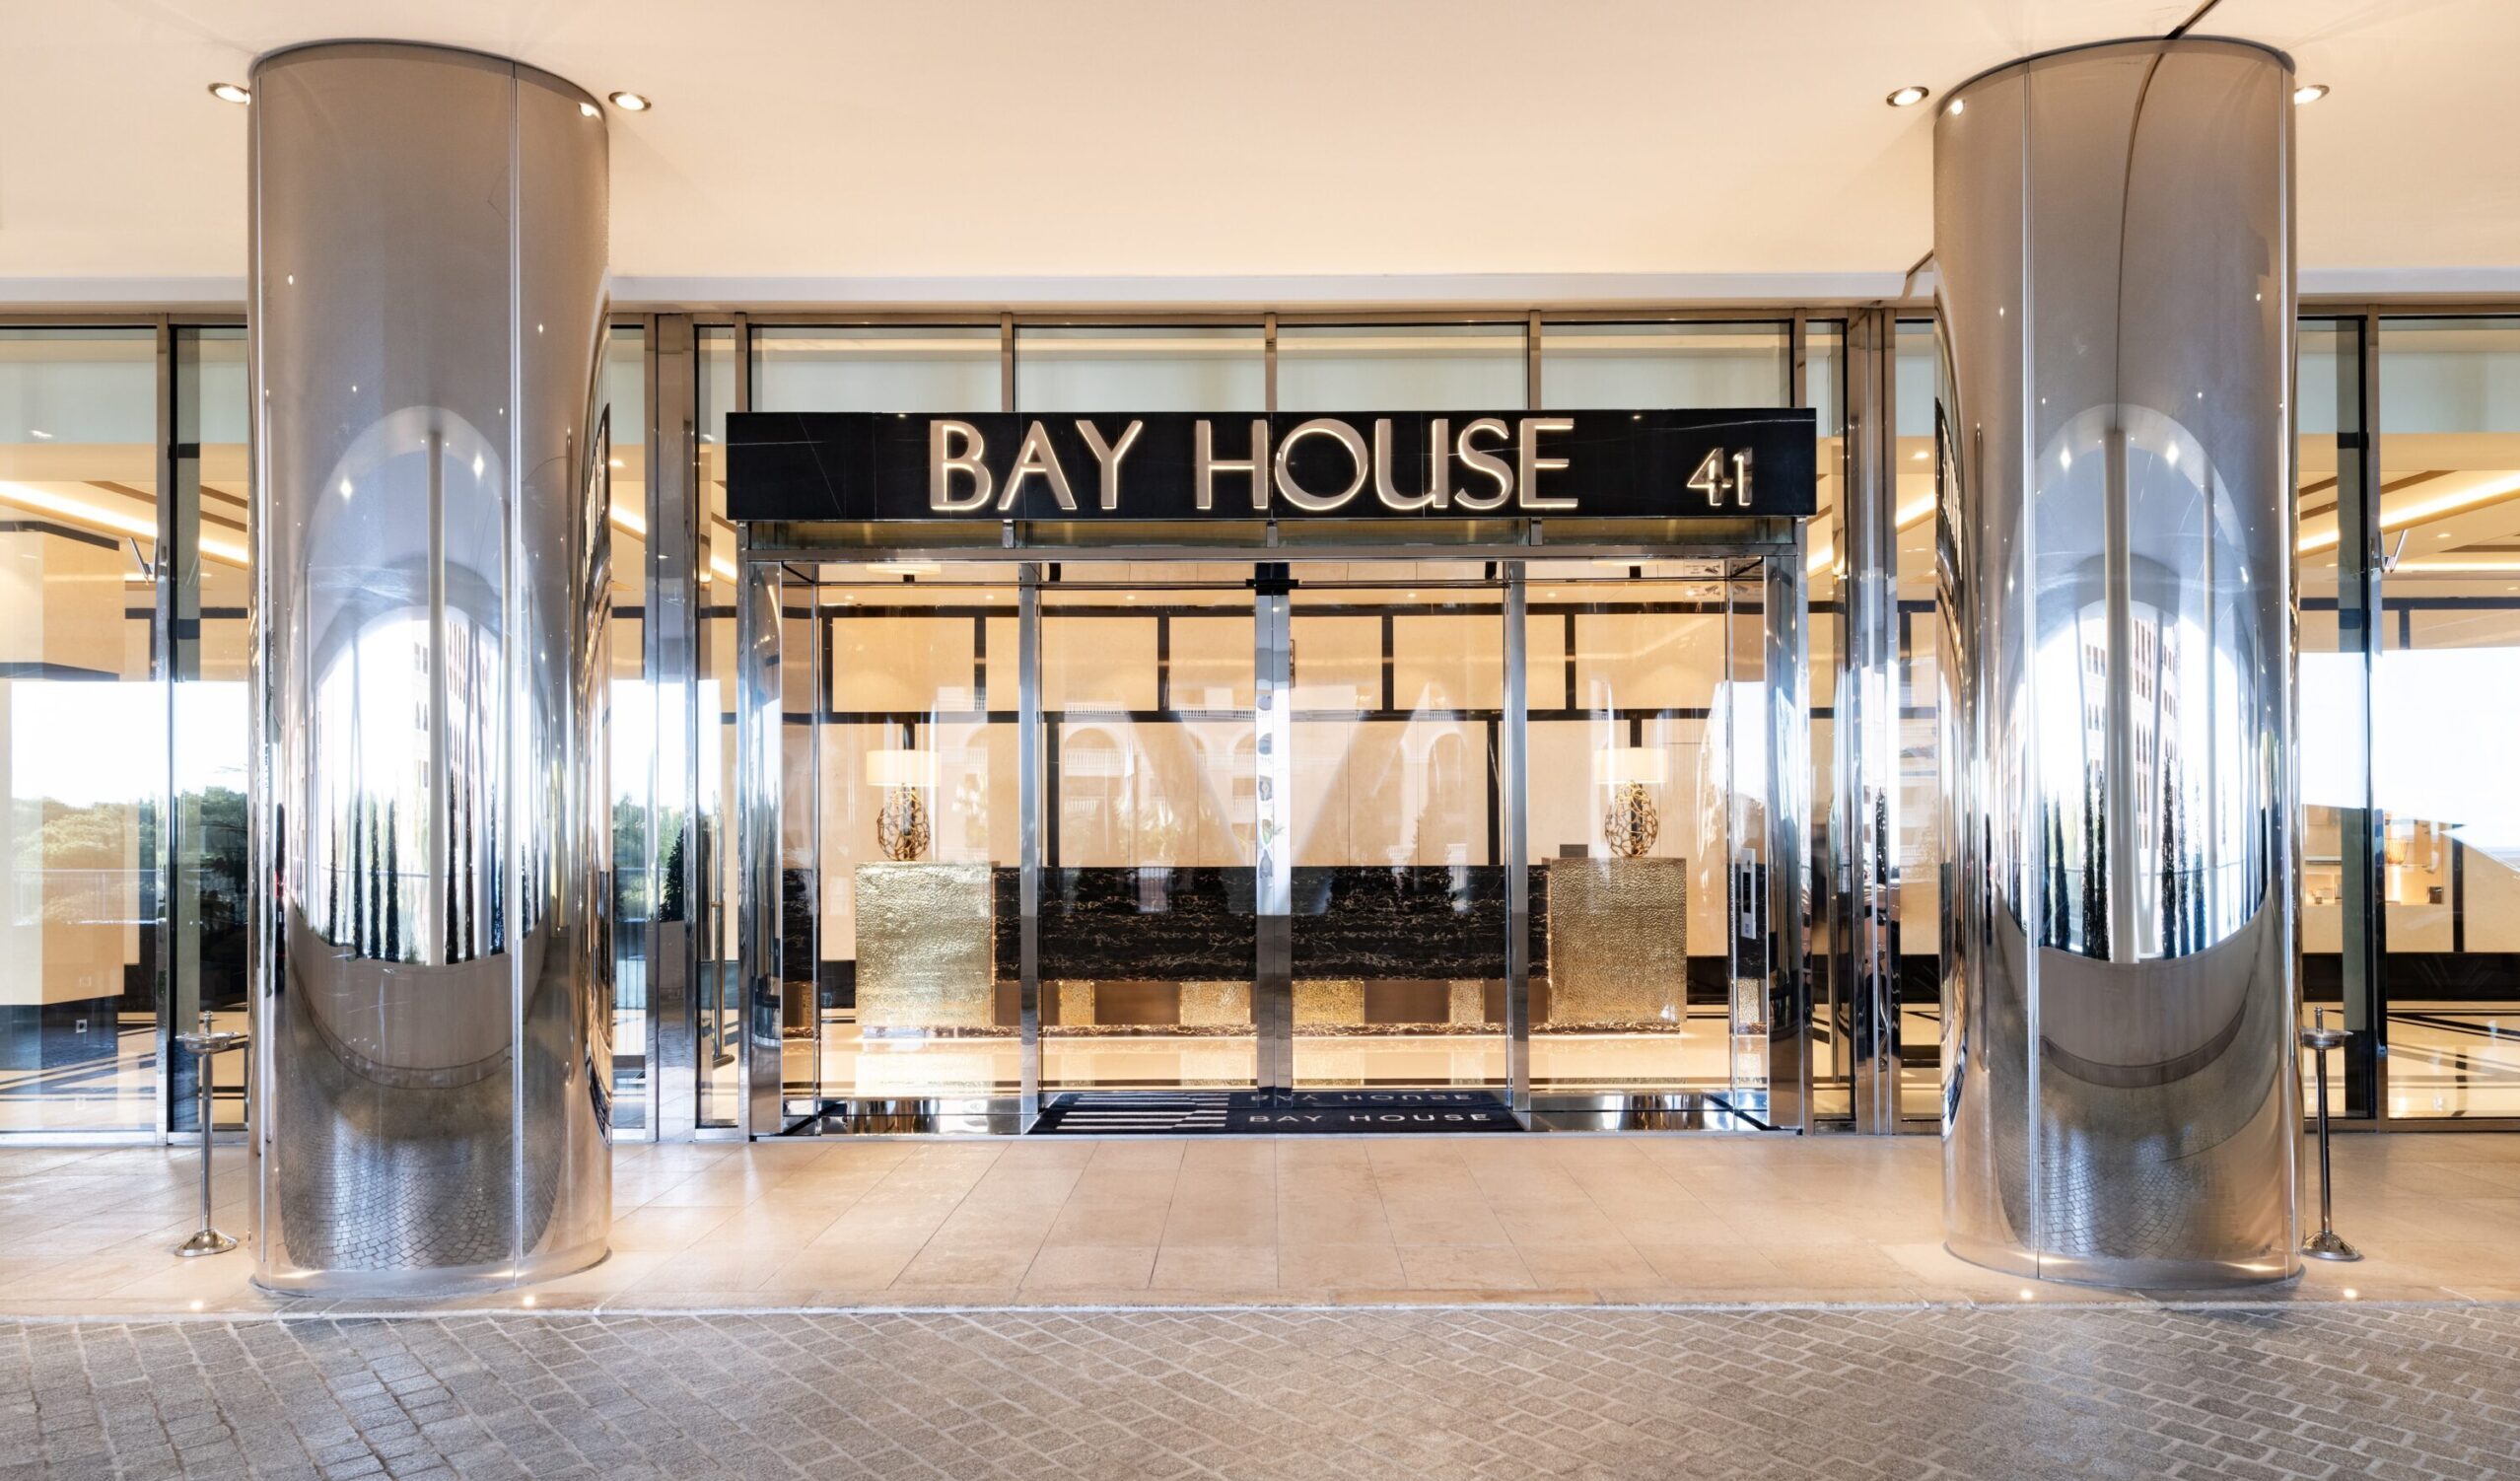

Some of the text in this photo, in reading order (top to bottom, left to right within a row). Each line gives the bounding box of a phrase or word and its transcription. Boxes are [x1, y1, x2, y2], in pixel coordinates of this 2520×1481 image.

[930, 417, 1578, 511] BAY HOUSE
[1686, 447, 1753, 507] 41
[1248, 1113, 1492, 1123] BAY HOUSE
